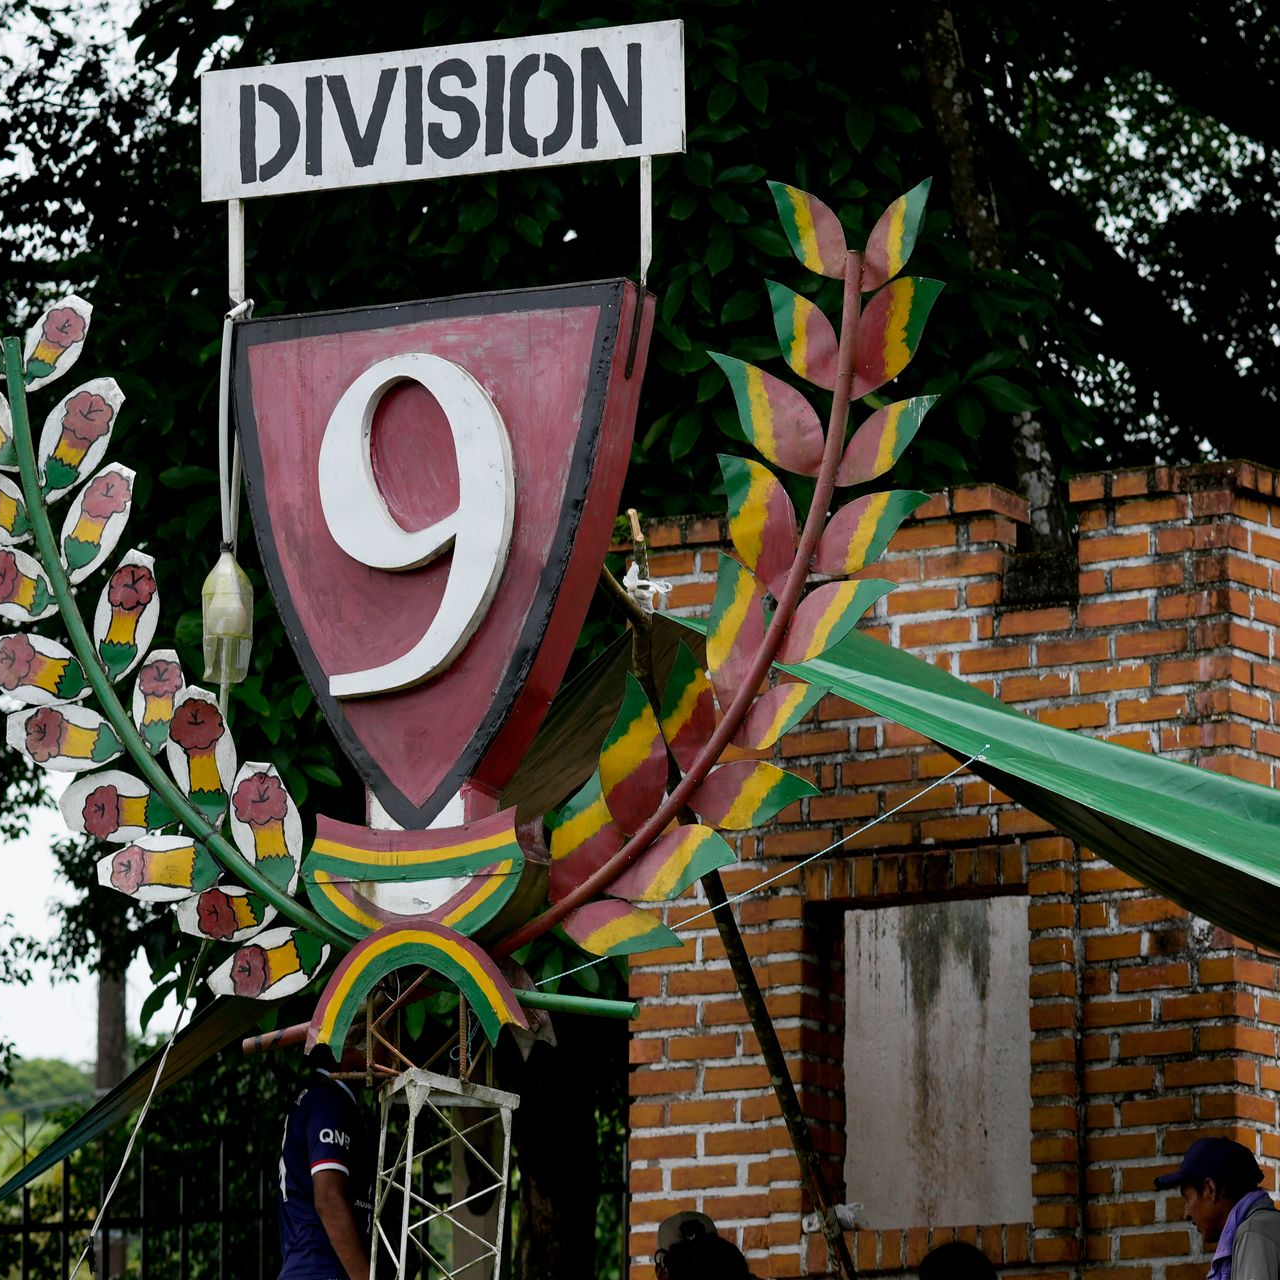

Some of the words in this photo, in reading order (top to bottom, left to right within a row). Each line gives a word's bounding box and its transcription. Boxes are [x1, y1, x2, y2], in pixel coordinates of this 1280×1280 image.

[239, 43, 643, 184] DIVISION
[318, 352, 516, 699] 9
[319, 1128, 351, 1150] QNB
